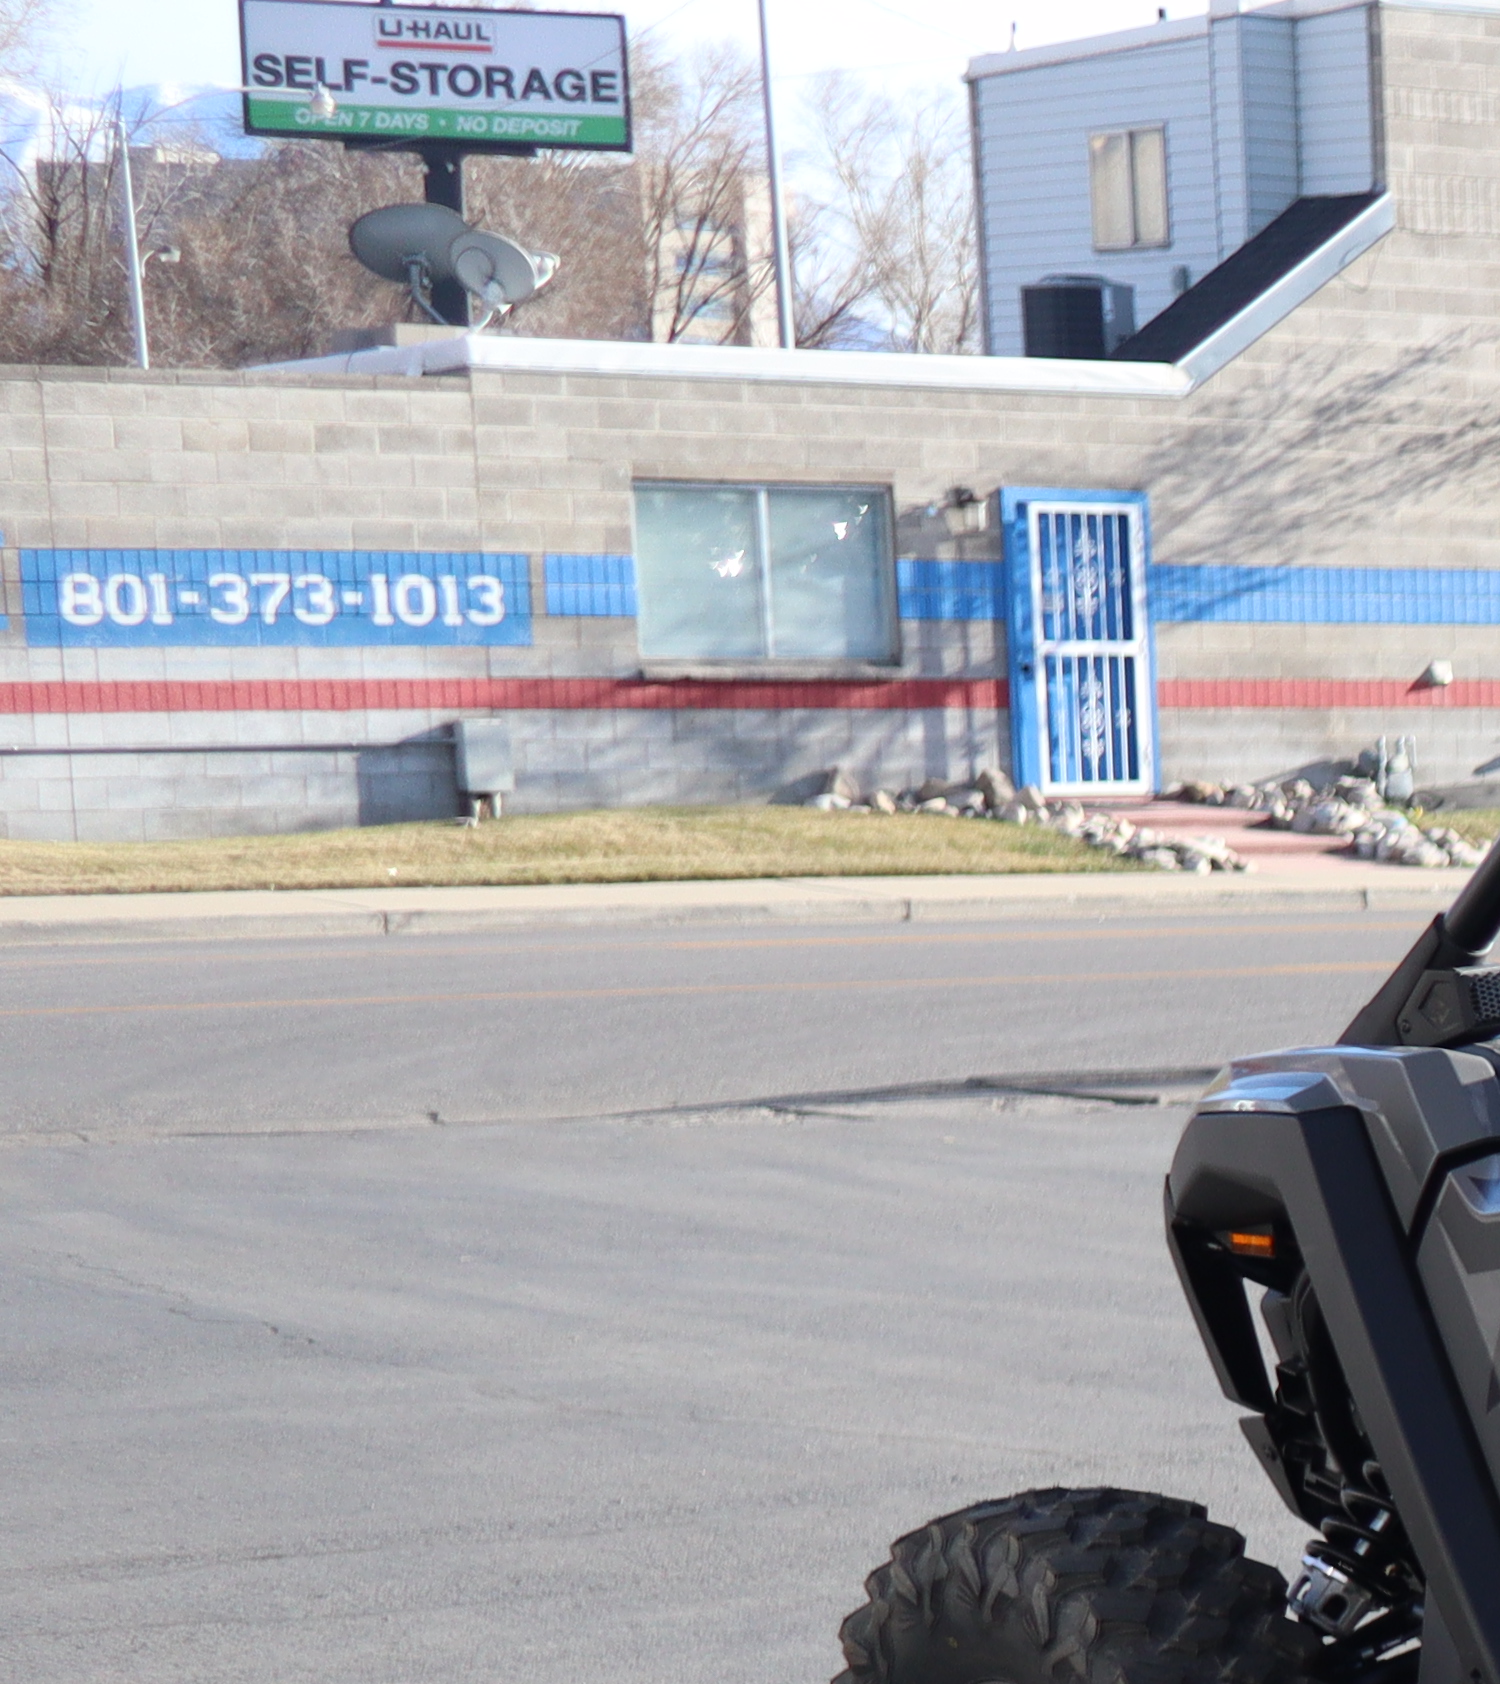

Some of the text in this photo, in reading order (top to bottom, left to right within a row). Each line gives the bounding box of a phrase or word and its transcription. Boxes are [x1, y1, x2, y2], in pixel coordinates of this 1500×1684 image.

[378, 18, 492, 42] U-HAUL
[252, 53, 620, 103] SELF-STORAGE
[357, 110, 372, 128] 7
[374, 111, 431, 131] DAYS
[456, 116, 488, 134] NO
[491, 117, 583, 137] DEPOSIT
[60, 572, 506, 627] 801-373-1013
